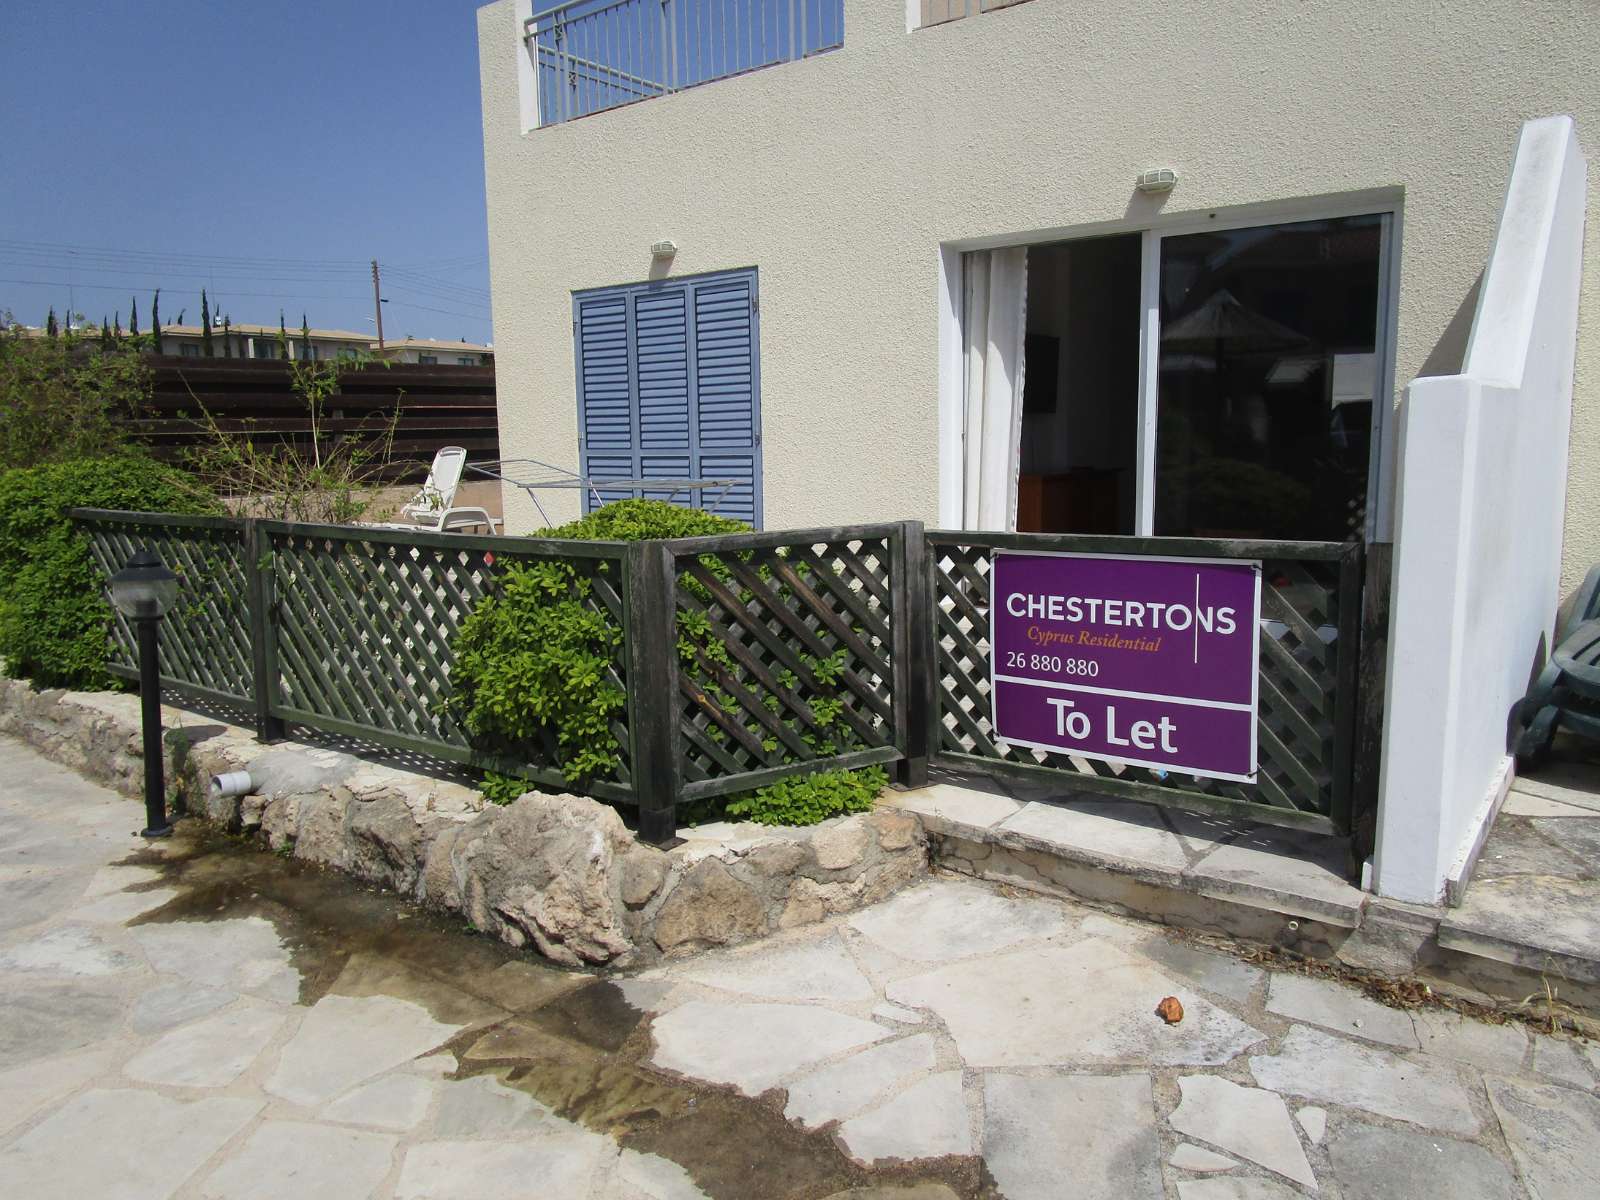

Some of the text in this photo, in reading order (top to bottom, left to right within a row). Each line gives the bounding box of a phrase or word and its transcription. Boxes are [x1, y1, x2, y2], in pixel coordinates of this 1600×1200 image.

[1006, 592, 1237, 635] CHESTERTONS
[1027, 626, 1162, 652] Cyprus Residential
[1006, 651, 1099, 677] 26 880 880
[1046, 697, 1179, 754] To Let
